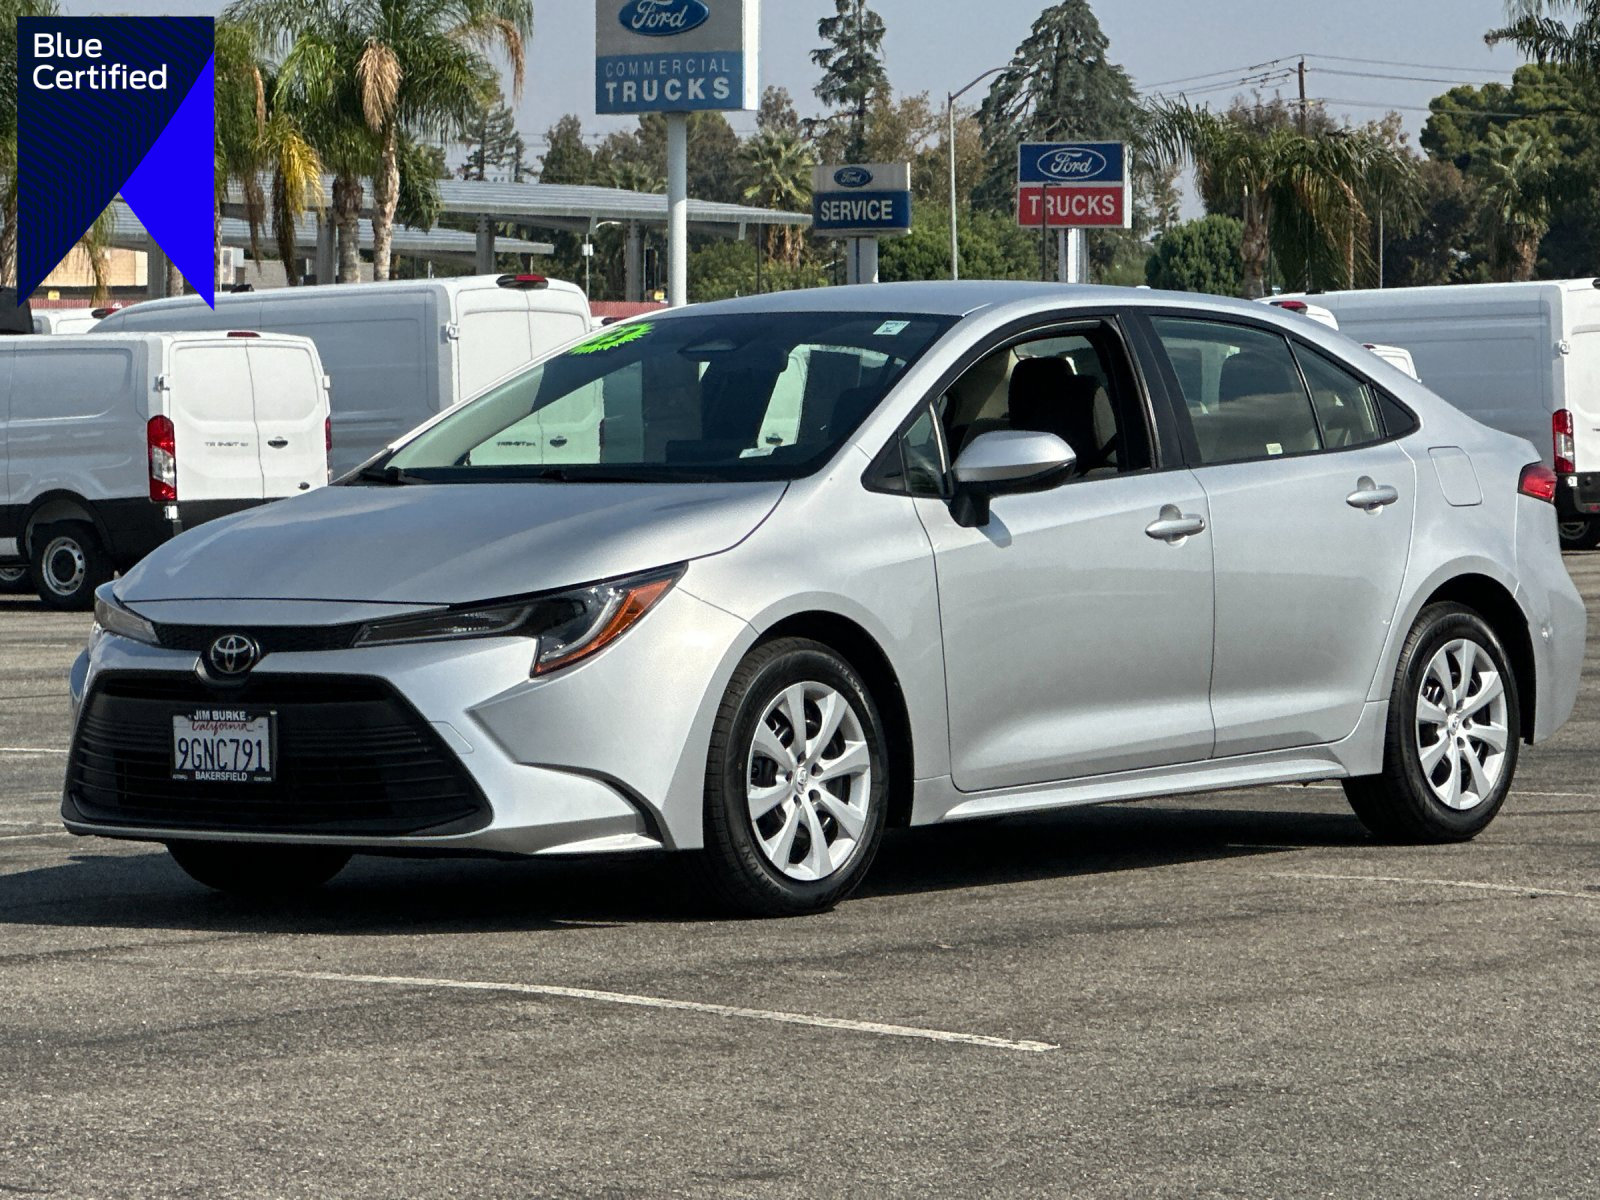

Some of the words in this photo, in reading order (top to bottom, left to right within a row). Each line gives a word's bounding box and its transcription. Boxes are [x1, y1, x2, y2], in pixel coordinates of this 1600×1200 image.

[632, 0, 689, 29] Ford
[605, 58, 730, 78] COMMERCIAL
[605, 77, 730, 103] TRUCKS
[1050, 152, 1093, 173] Ford
[820, 200, 893, 221] SERVICE
[1028, 195, 1115, 216] TRUCKS
[194, 710, 210, 721] JIM
[212, 710, 246, 721] BURKE
[192, 721, 254, 736] California
[178, 738, 265, 770] 9GNC791
[195, 771, 248, 781] BAKERSFIELD
